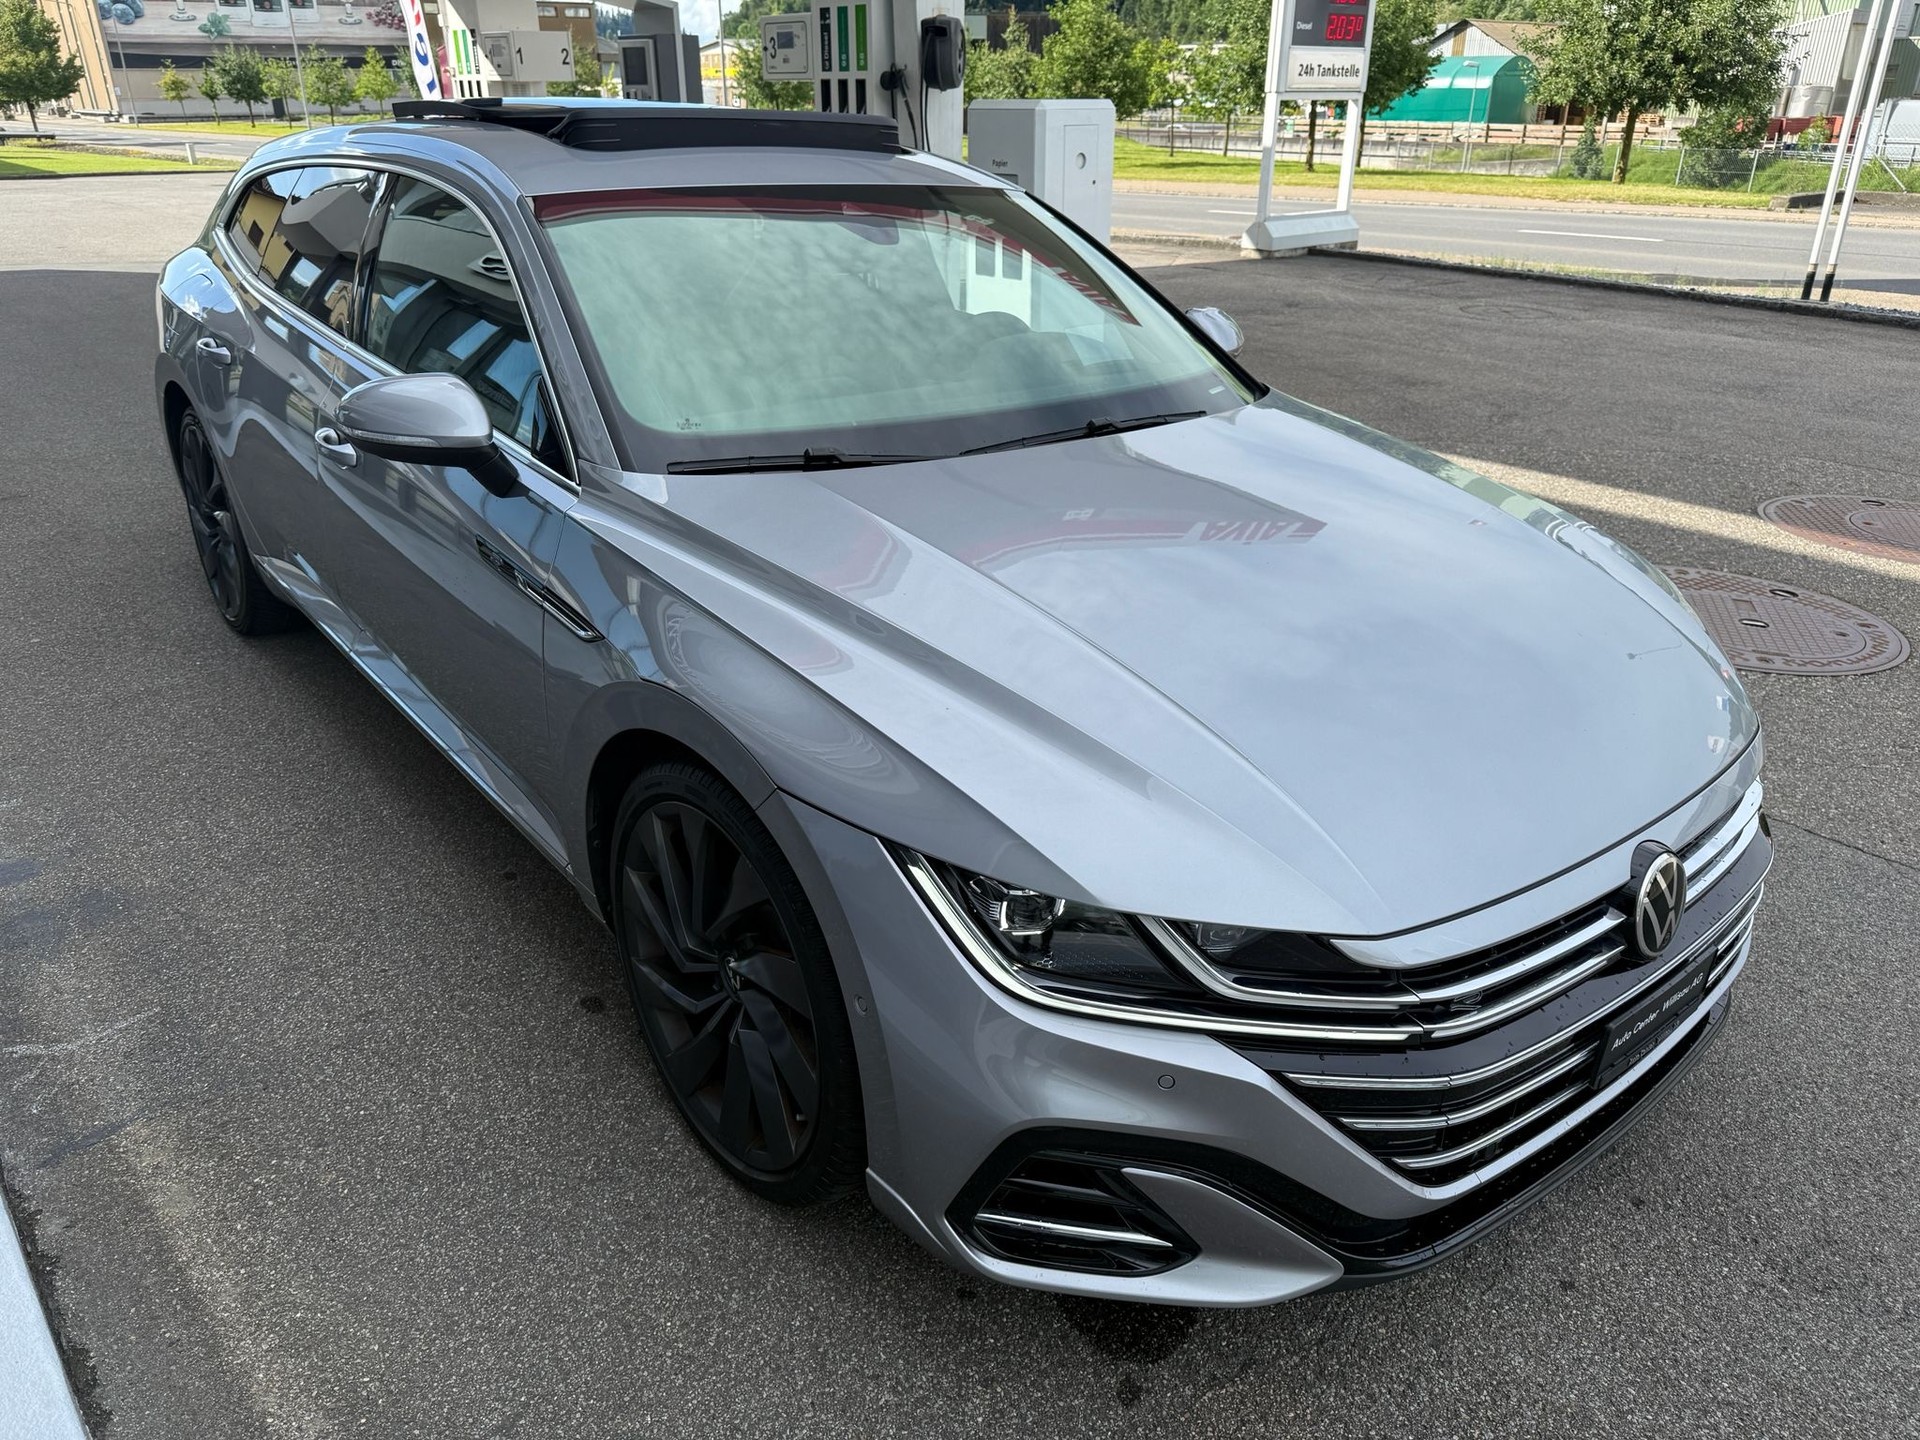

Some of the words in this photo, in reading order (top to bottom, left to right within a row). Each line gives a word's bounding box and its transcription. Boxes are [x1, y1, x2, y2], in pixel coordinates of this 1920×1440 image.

[1296, 21, 1313, 30] Diesel
[516, 47, 524, 65] 1
[561, 47, 570, 65] 2
[769, 36, 777, 59] 3
[1298, 63, 1315, 77] 24h
[1317, 63, 1360, 78] Tankstelle
[992, 159, 1008, 169] Papier
[1611, 1030, 1632, 1051] Auto
[1633, 1007, 1659, 1034] Center
[1690, 972, 1704, 990] AG
